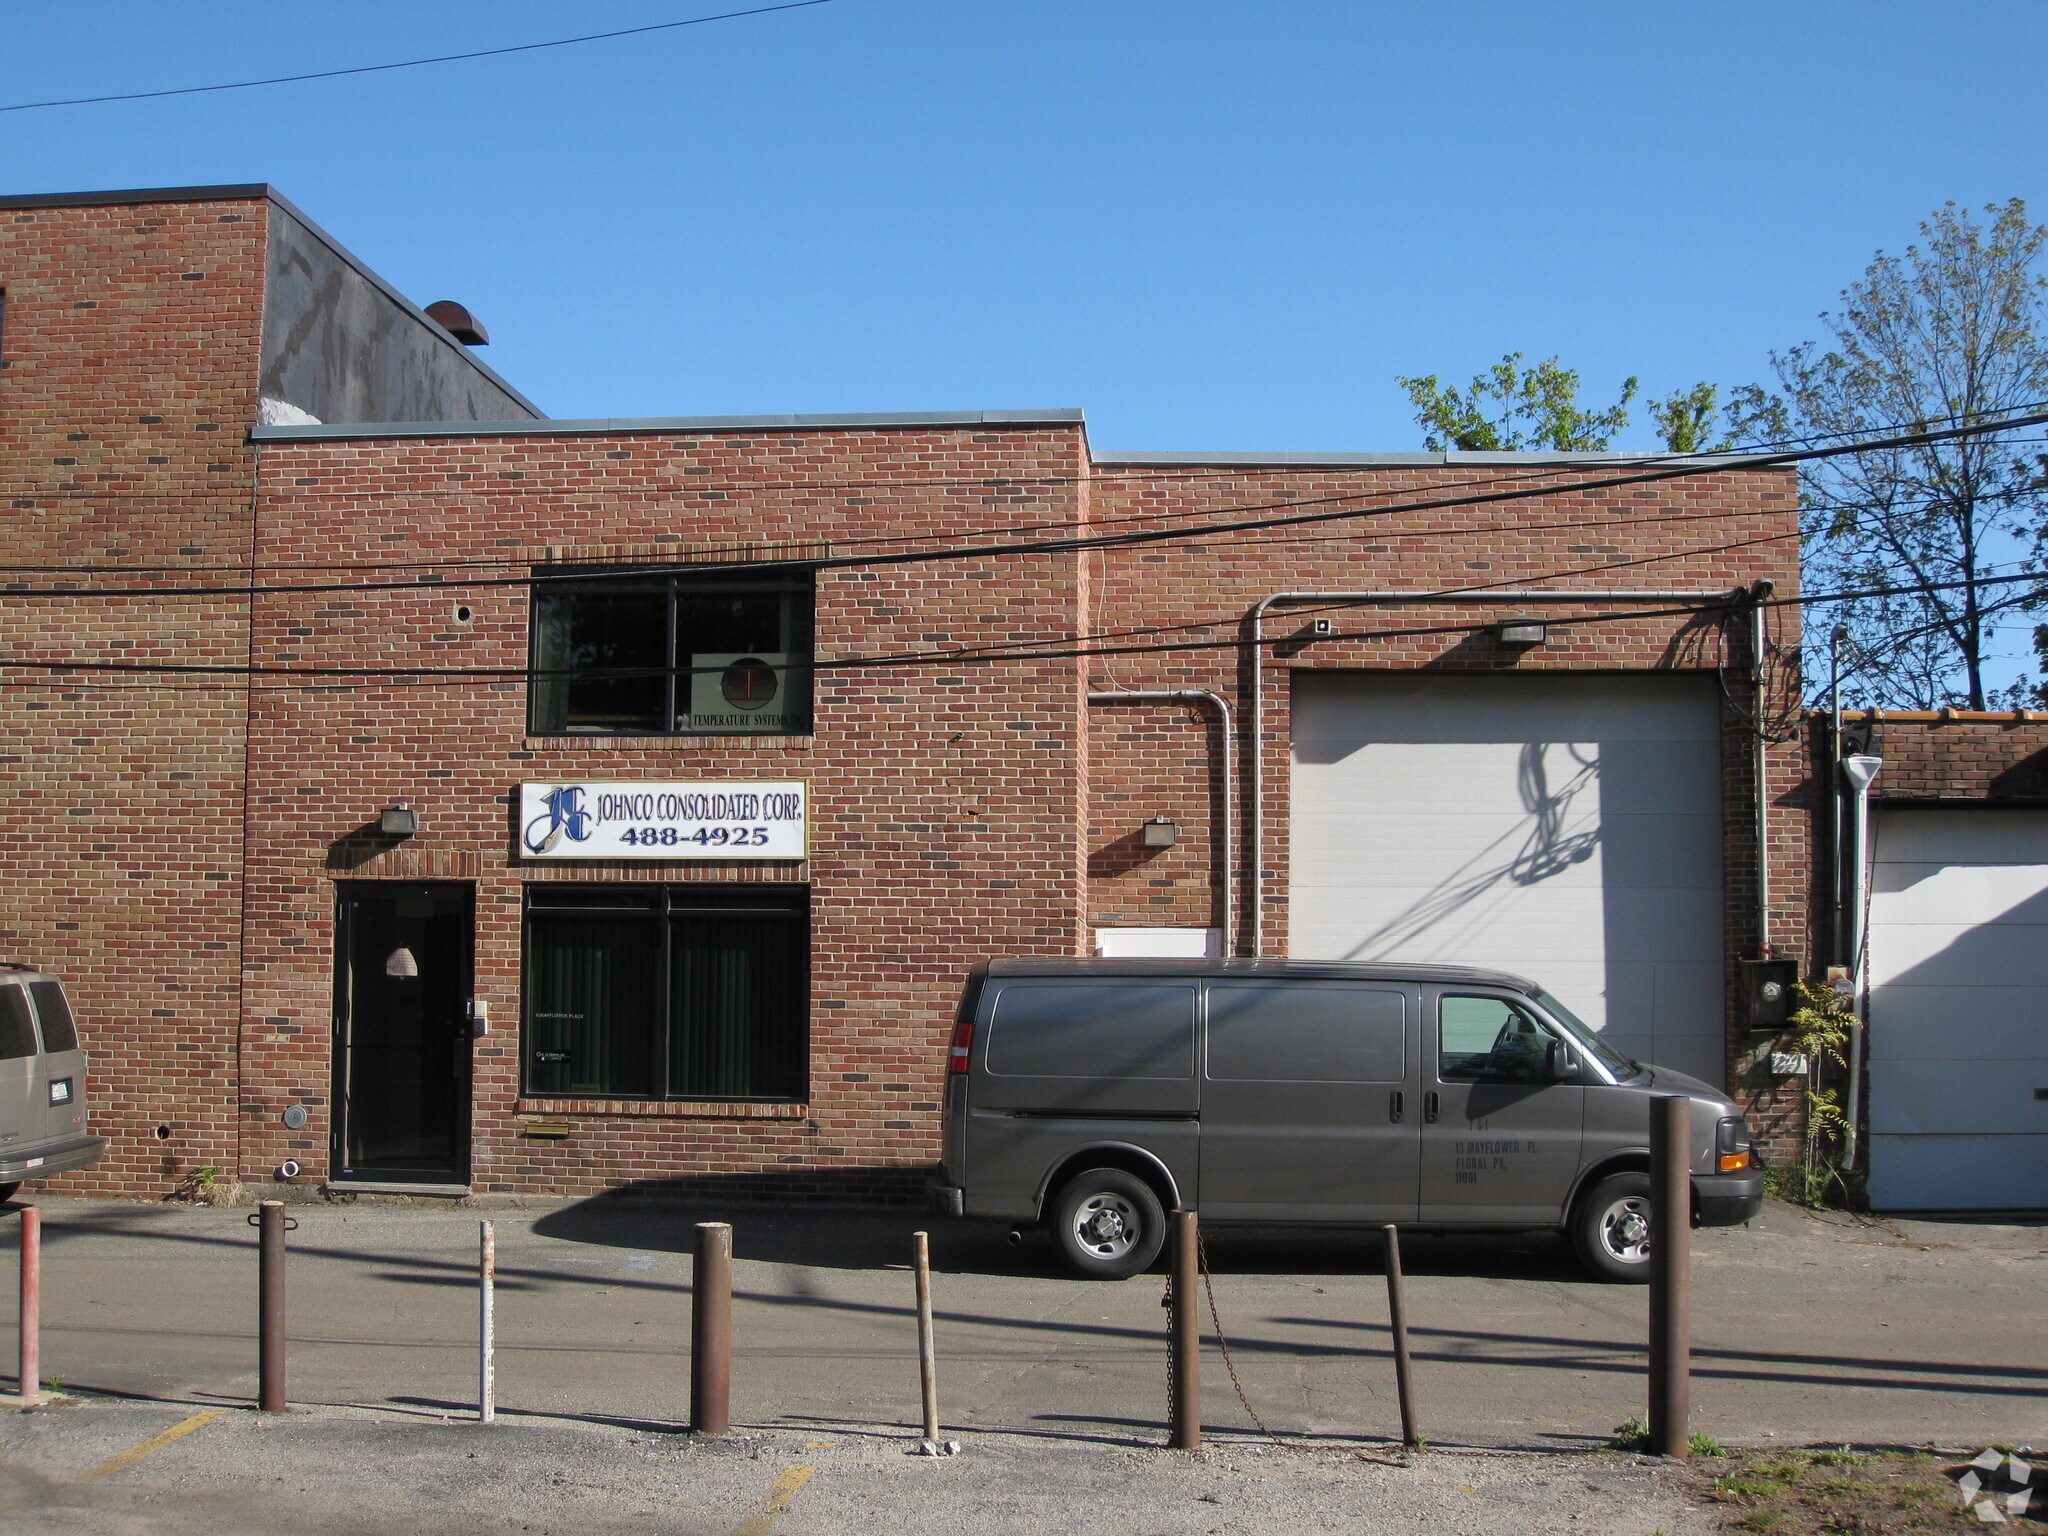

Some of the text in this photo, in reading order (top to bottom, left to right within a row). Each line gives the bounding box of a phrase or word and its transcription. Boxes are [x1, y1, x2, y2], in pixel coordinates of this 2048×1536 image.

[693, 714, 750, 726] TEMPERATURE
[596, 793, 802, 826] JOHNCO CONSOLIDATED CORP.
[619, 827, 769, 846] 488-4925
[1467, 1141, 1520, 1154] MAYFLOWER
[1456, 1158, 1488, 1170] FLORAL
[1456, 1171, 1477, 1184] 11001
